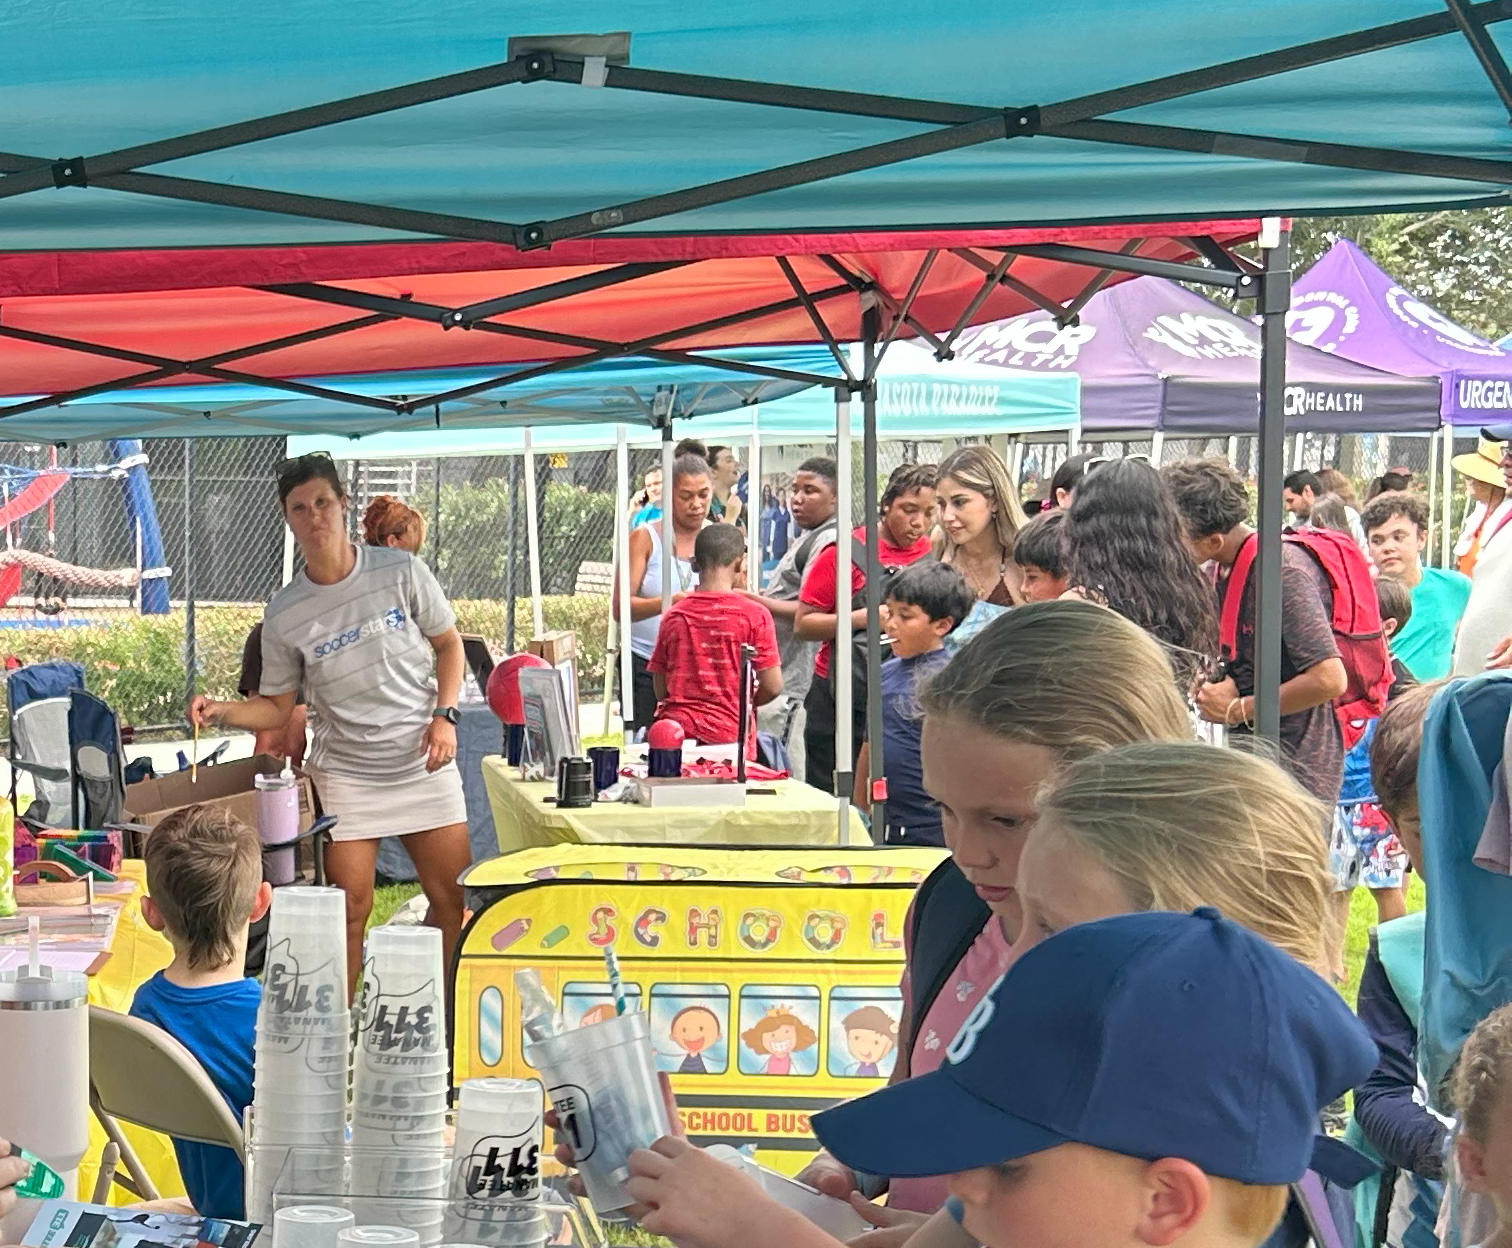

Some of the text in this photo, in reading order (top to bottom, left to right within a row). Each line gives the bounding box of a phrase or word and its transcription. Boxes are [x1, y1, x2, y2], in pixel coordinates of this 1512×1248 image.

[1284, 386, 1364, 416] CR HEALTH
[587, 904, 904, 953] SCHOOL
[676, 1111, 811, 1134] SCHOOL BUS
